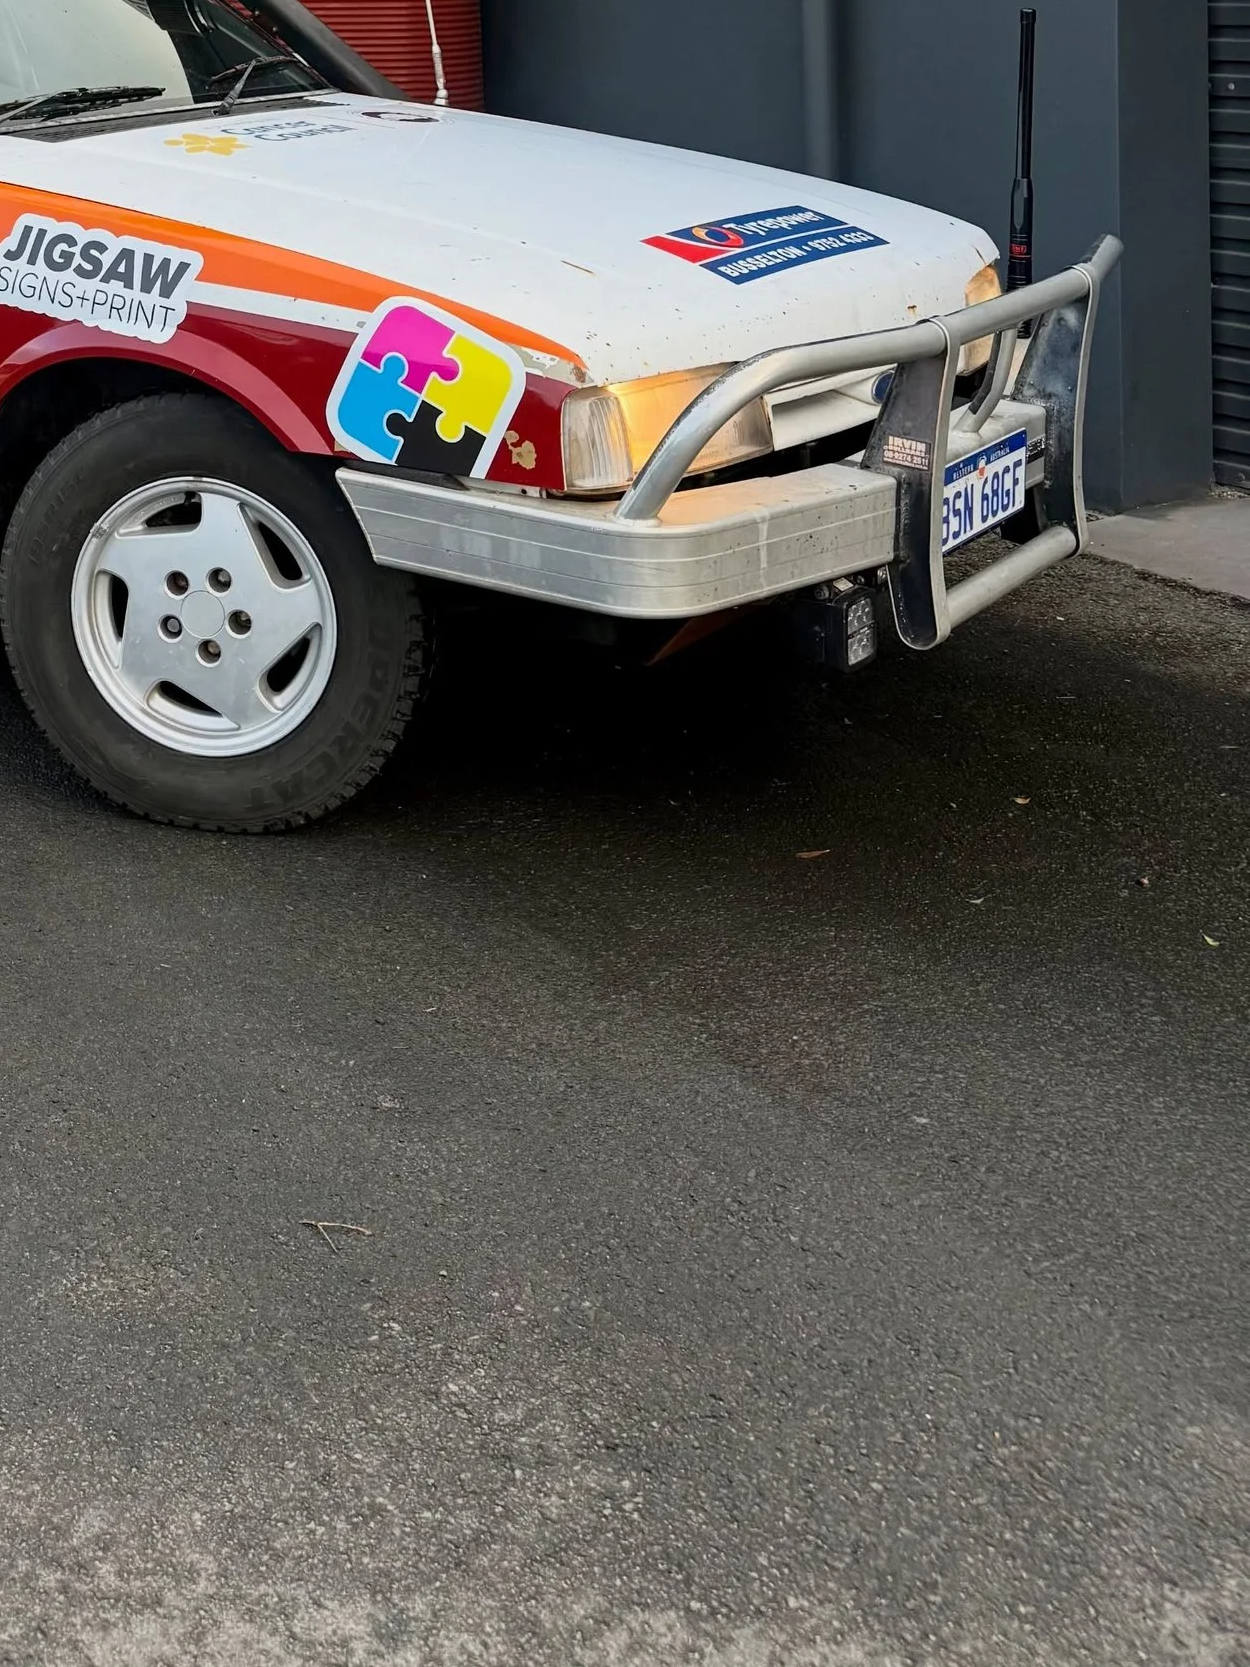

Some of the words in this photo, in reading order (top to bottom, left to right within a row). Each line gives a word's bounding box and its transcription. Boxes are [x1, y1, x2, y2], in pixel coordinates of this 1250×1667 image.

[722, 210, 824, 236] Tyrepower
[3, 224, 192, 299] JIGSAW
[717, 245, 808, 278] BUSSELTON
[981, 458, 1023, 524] 68GF
